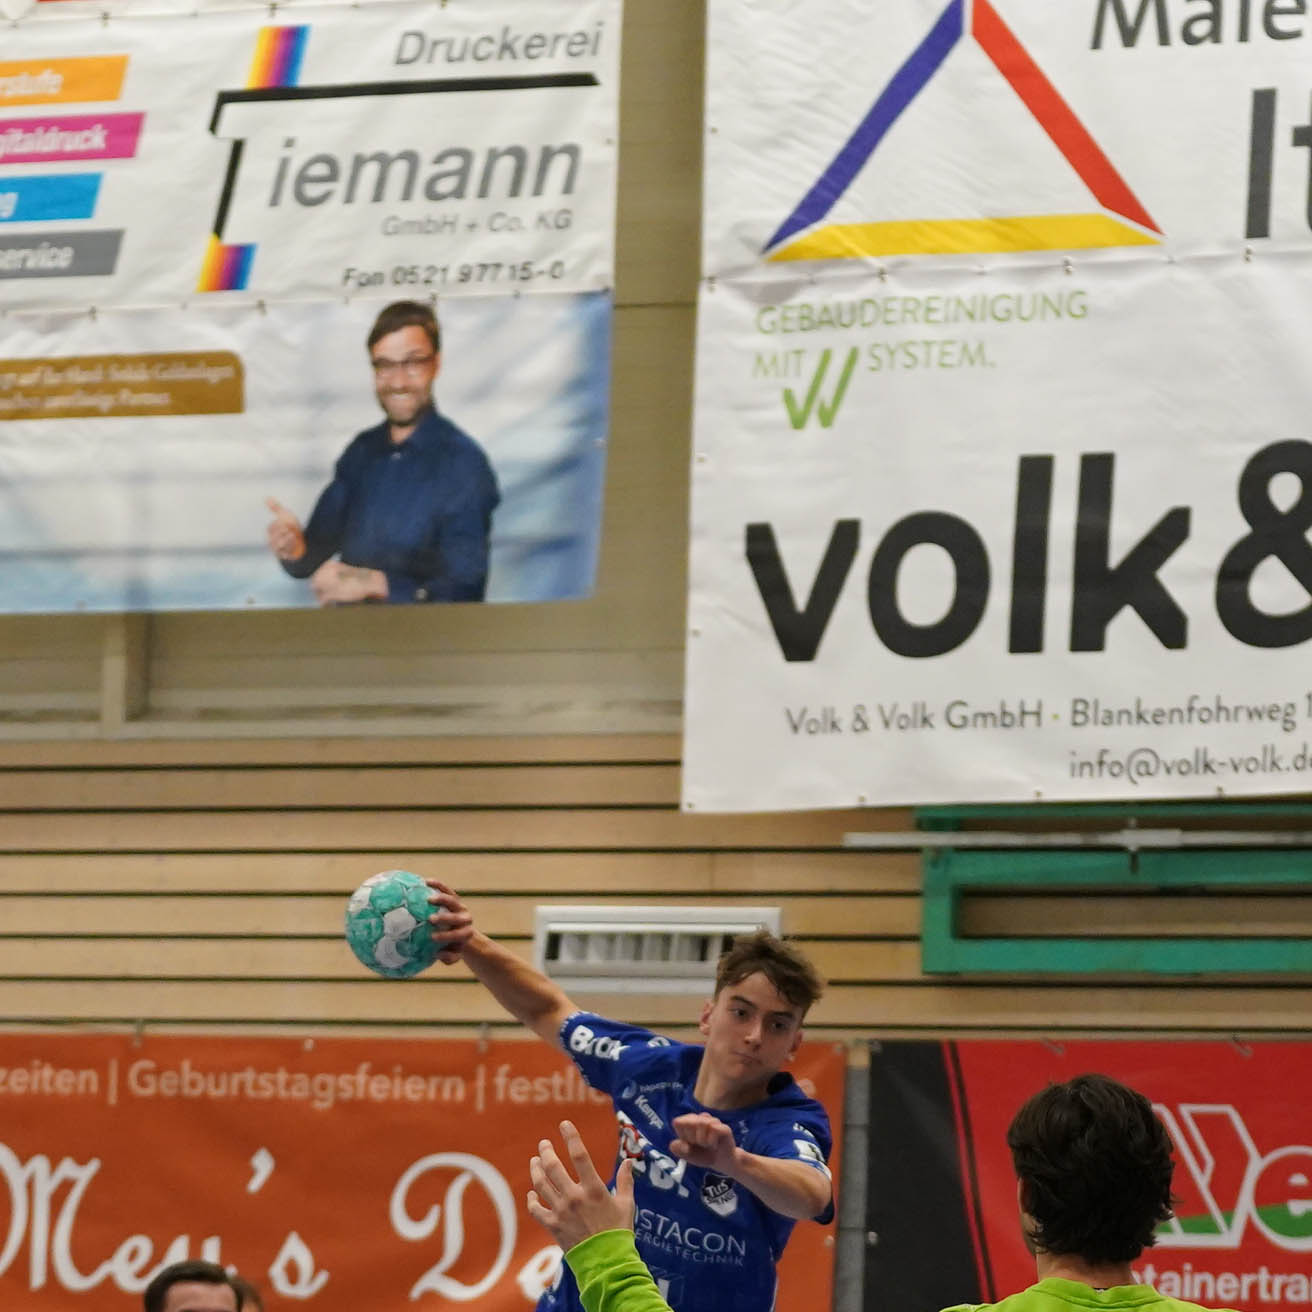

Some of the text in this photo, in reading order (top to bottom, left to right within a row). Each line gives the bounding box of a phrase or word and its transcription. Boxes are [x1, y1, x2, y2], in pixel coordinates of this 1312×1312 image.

[394, 21, 604, 66] Druckerei
[382, 212, 459, 237] GmbH
[536, 208, 573, 230] KG
[391, 264, 449, 286] 0521
[752, 339, 997, 380] MIT SYSTEM.
[784, 707, 843, 735] Volk
[850, 705, 871, 733] &
[877, 702, 936, 732] Volk
[945, 699, 1043, 730] GmbH
[1070, 694, 1298, 732] Blankenfohrweg
[128, 1059, 467, 1109] Geburtstagsfeiern
